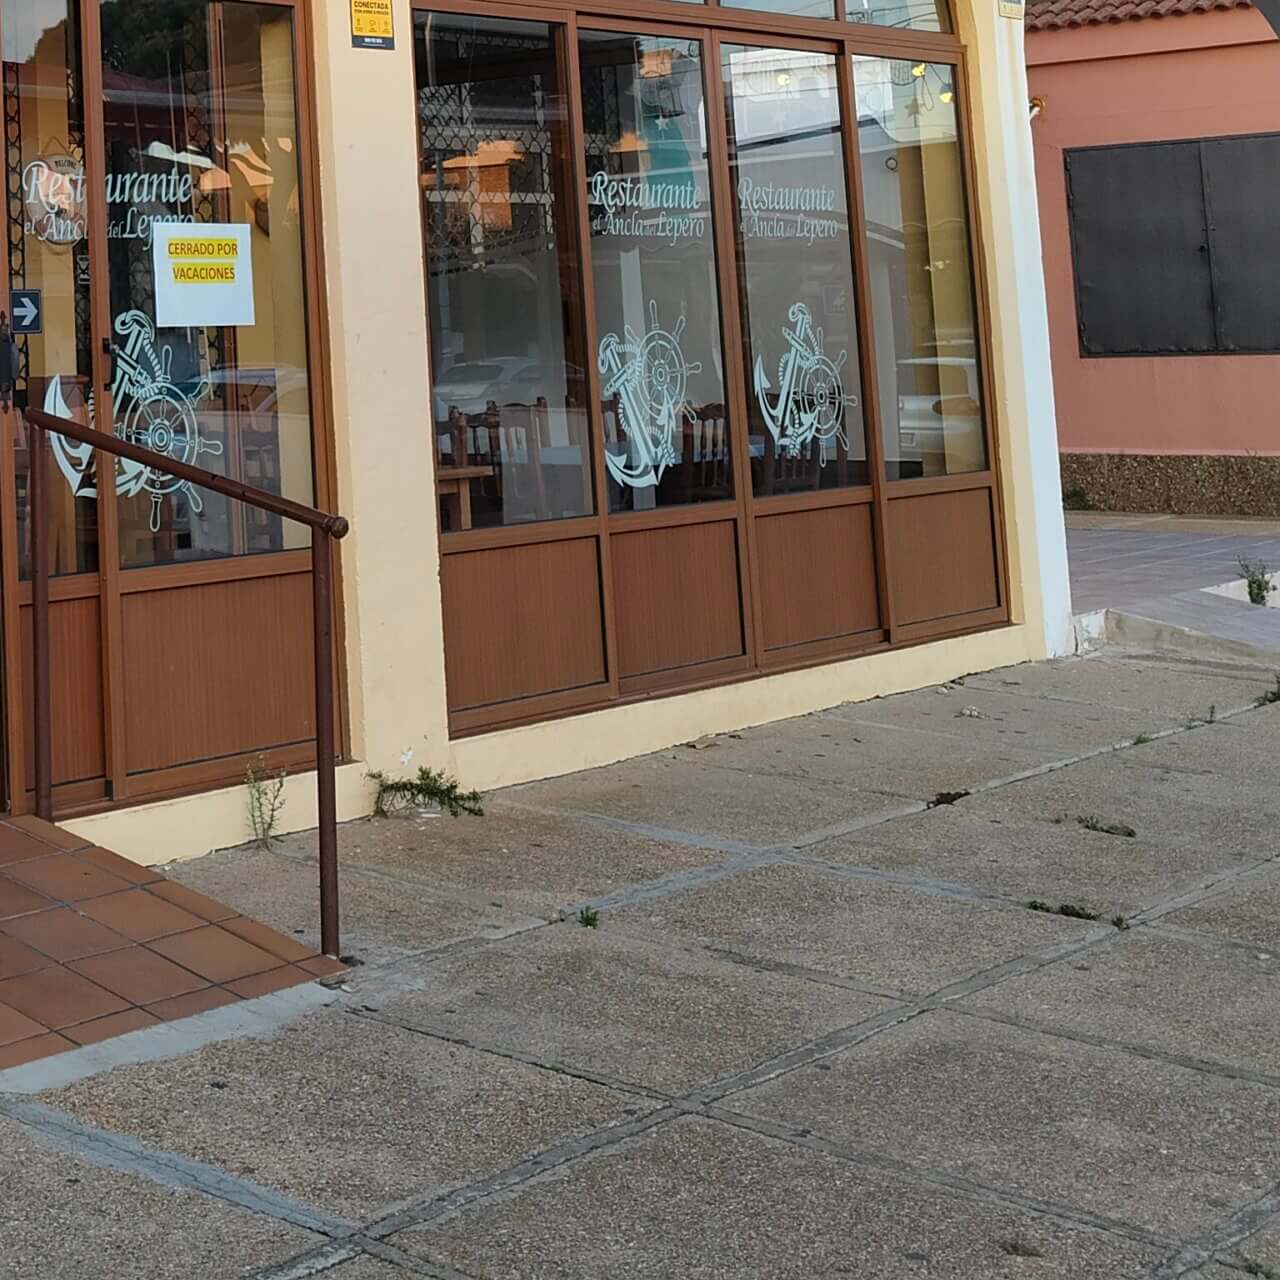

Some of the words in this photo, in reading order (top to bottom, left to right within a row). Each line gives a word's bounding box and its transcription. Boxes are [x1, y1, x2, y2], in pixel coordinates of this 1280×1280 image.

[353, 0, 389, 10] CONECTADA
[22, 161, 193, 213] Resturante
[591, 171, 702, 213] Restaurante
[737, 176, 835, 217] Restaurante
[23, 216, 38, 235] el
[601, 210, 643, 237] Ancla
[656, 210, 705, 247] Lepero
[747, 213, 785, 237] Ancla
[796, 212, 838, 248] Lepero
[167, 242, 214, 256] CERRADO
[217, 242, 239, 256] POR
[172, 266, 236, 280] VACACIONES
